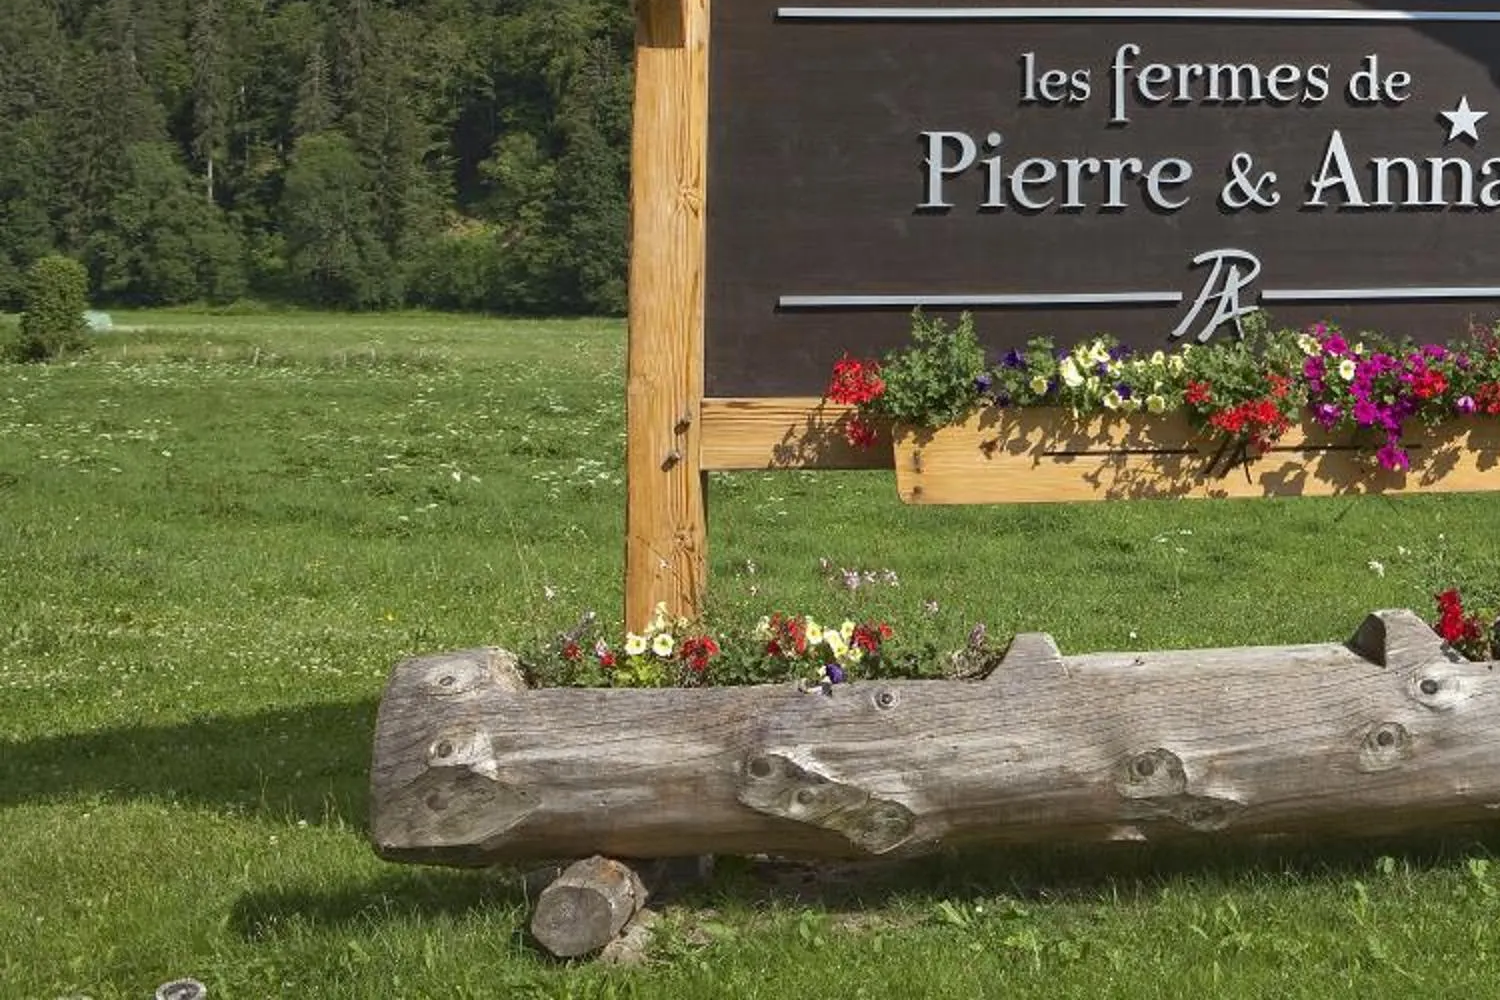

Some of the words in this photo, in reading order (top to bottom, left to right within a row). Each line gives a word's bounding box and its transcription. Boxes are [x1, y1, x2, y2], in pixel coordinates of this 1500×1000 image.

[1022, 51, 1092, 103] les
[1111, 42, 1331, 122] fermes
[1348, 53, 1412, 103] de
[917, 129, 1193, 209] Pierre
[1222, 152, 1280, 208] &
